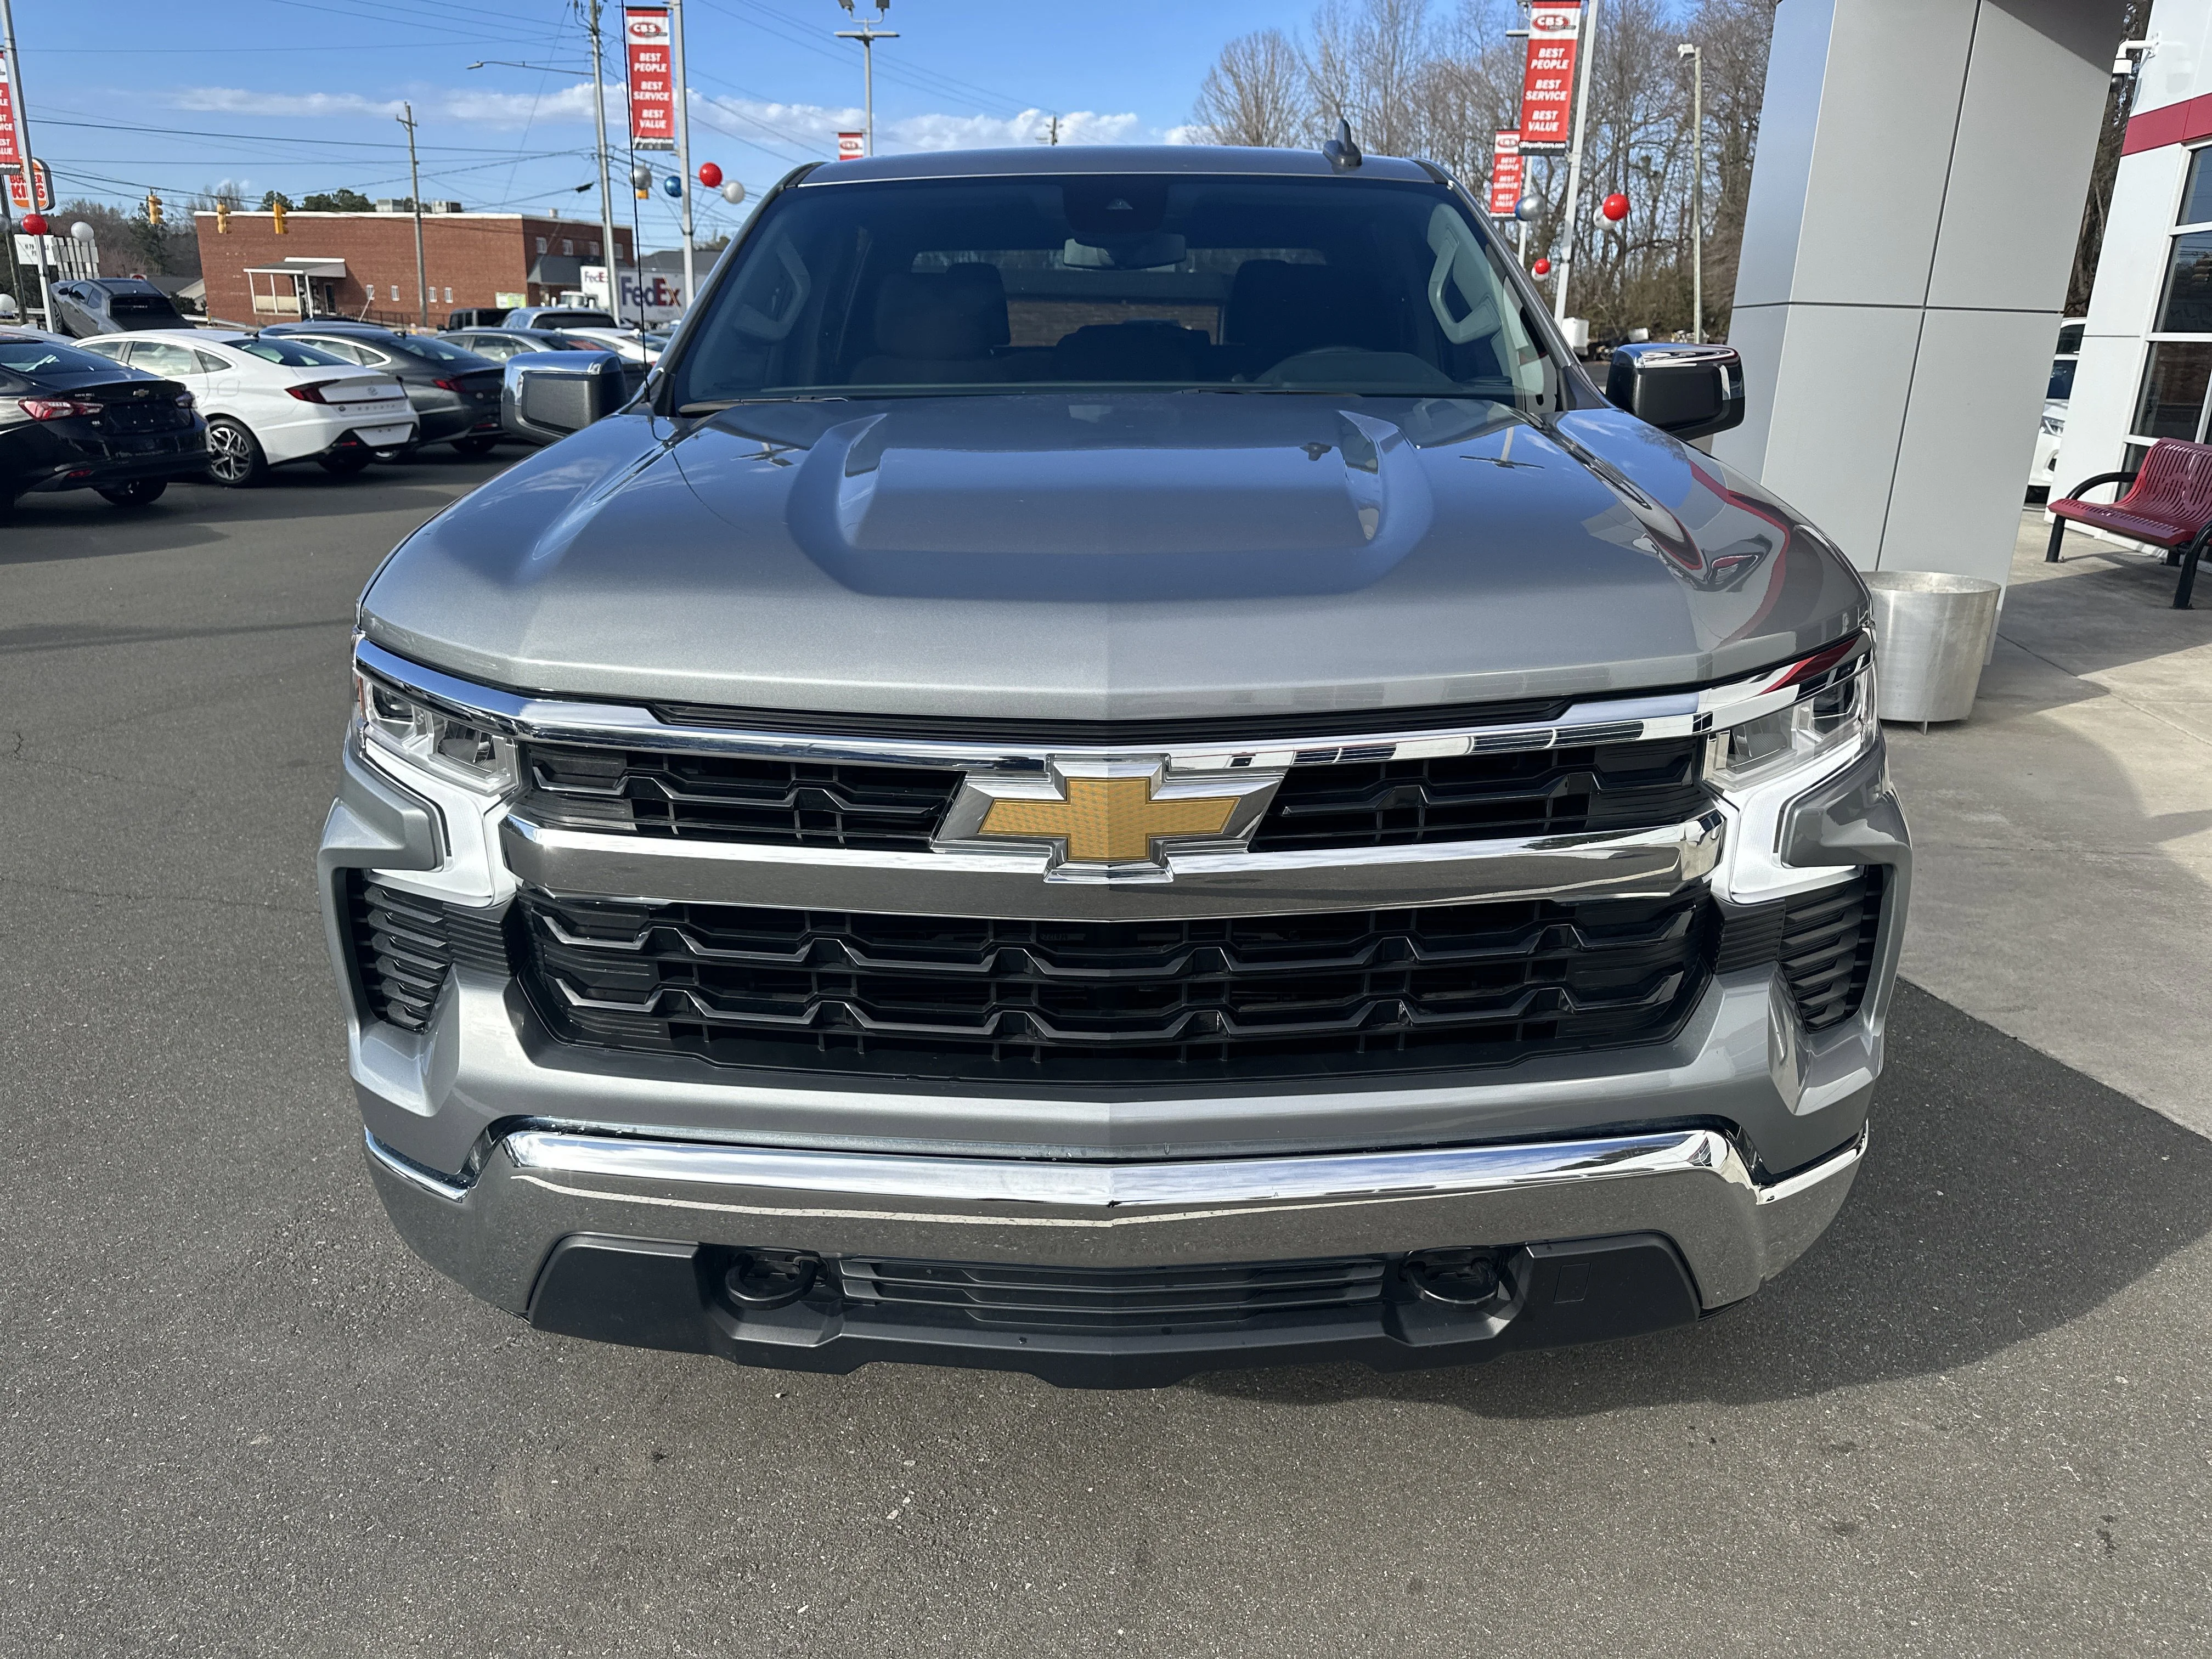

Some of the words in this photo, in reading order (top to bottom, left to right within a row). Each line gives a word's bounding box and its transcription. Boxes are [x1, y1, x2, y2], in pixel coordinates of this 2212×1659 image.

[1537, 17, 1564, 26] CBS
[633, 24, 656, 32] CBS
[639, 53, 661, 62] BEST
[1538, 48, 1565, 58] BEST
[634, 63, 667, 72] PEOPLE
[1530, 59, 1570, 70] PEOPLE
[640, 81, 663, 91] BEST
[1535, 79, 1562, 89] BEST
[633, 91, 670, 101] SERVICE
[1525, 90, 1567, 101] SERVICE
[642, 109, 664, 119] BEST
[1532, 110, 1559, 120] BEST
[639, 119, 667, 129] VALUE
[1528, 121, 1559, 132] VALUE
[10, 174, 43, 184] BUER
[11, 184, 45, 198] KIG
[621, 276, 681, 307] FedEx
